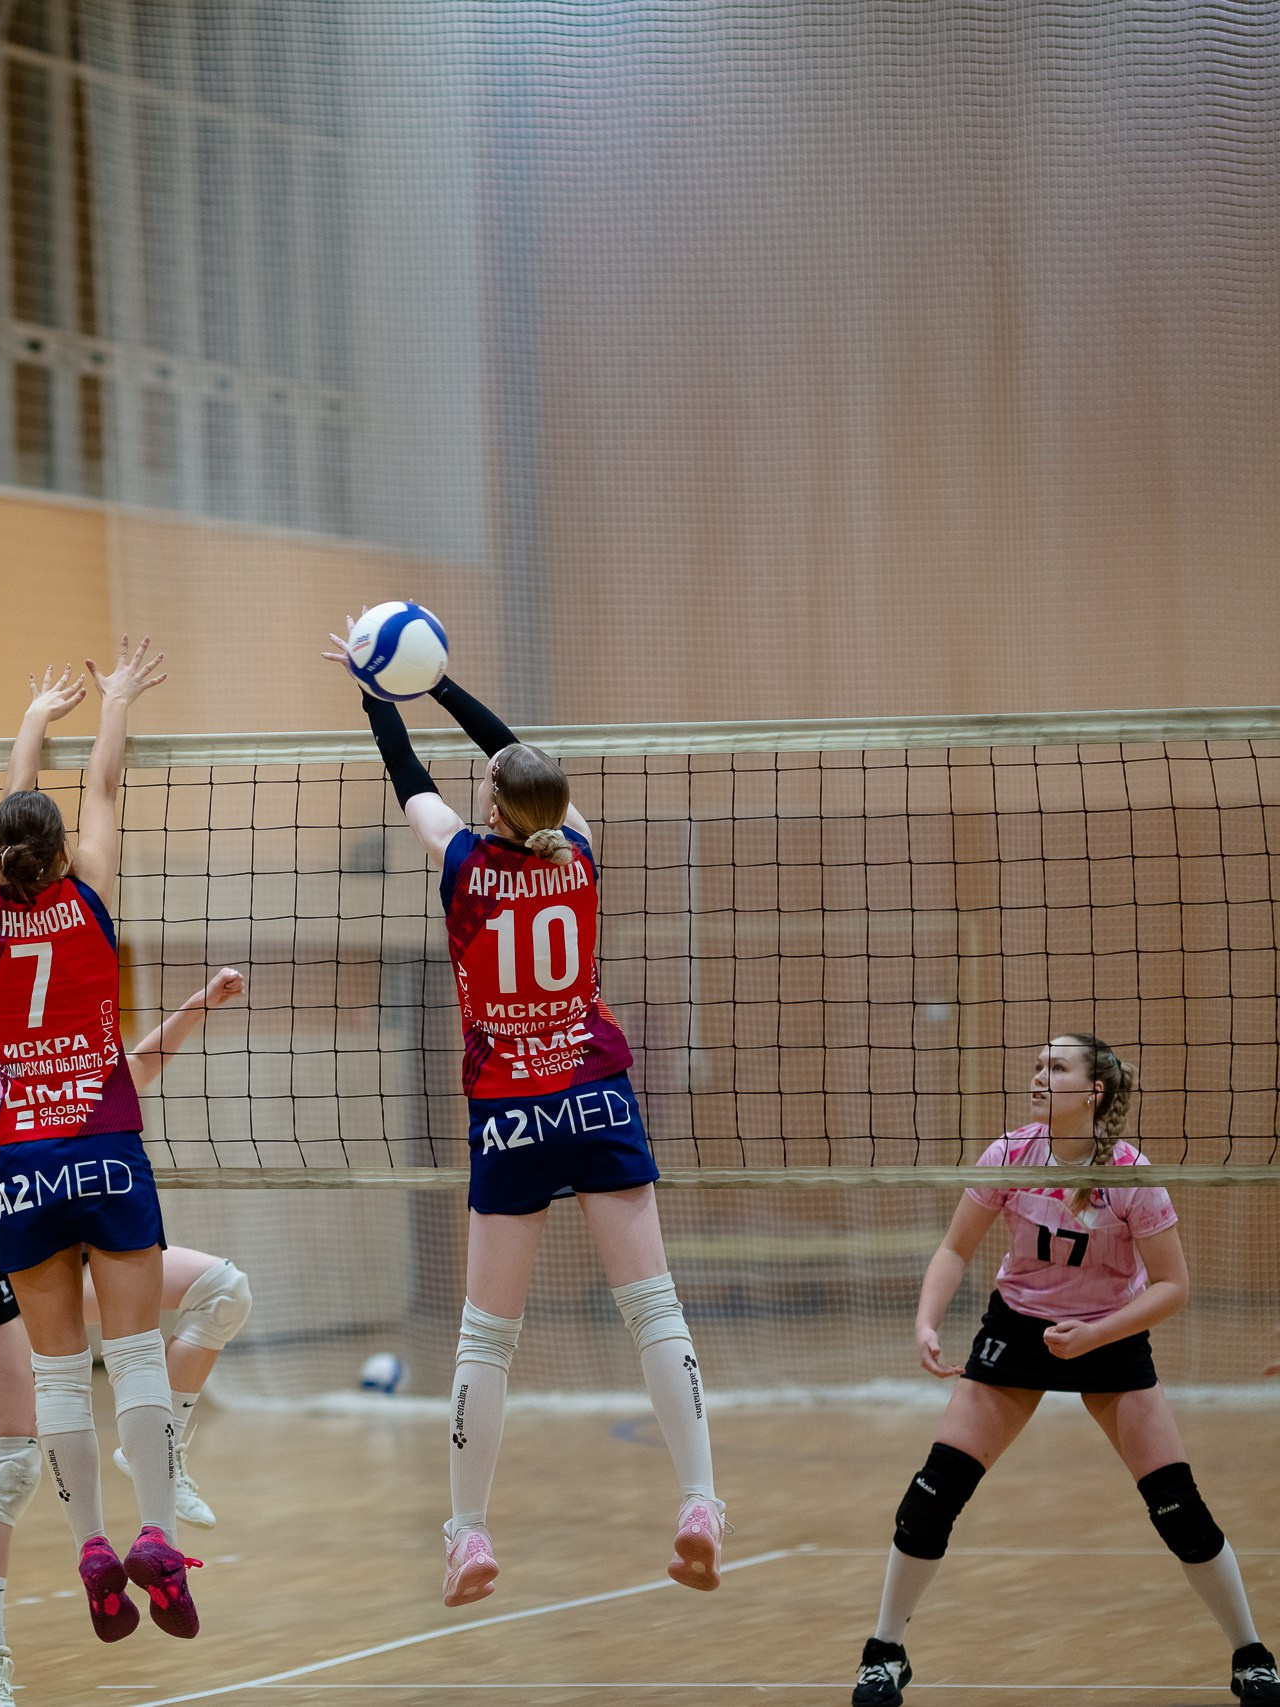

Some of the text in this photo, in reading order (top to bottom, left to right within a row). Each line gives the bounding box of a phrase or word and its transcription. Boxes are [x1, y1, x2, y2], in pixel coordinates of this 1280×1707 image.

[468, 861, 589, 901] АРДАЛИНА
[486, 905, 579, 994] 10
[10, 942, 53, 1029] 7
[485, 995, 586, 1018] ИСКРА
[100, 999, 120, 1066] A2MED
[3, 1033, 90, 1059] ИСКРА
[531, 1046, 590, 1067] GLOBAL
[55, 1052, 103, 1074] ОБЛАСТЬ
[533, 1056, 585, 1077] VISION
[4, 1073, 104, 1109] LIME
[39, 1103, 94, 1117] GLOBAL
[40, 1113, 88, 1127] VISION
[482, 1090, 631, 1156] A2MED
[1037, 1224, 1090, 1268] 17
[979, 1337, 1008, 1362] 17
